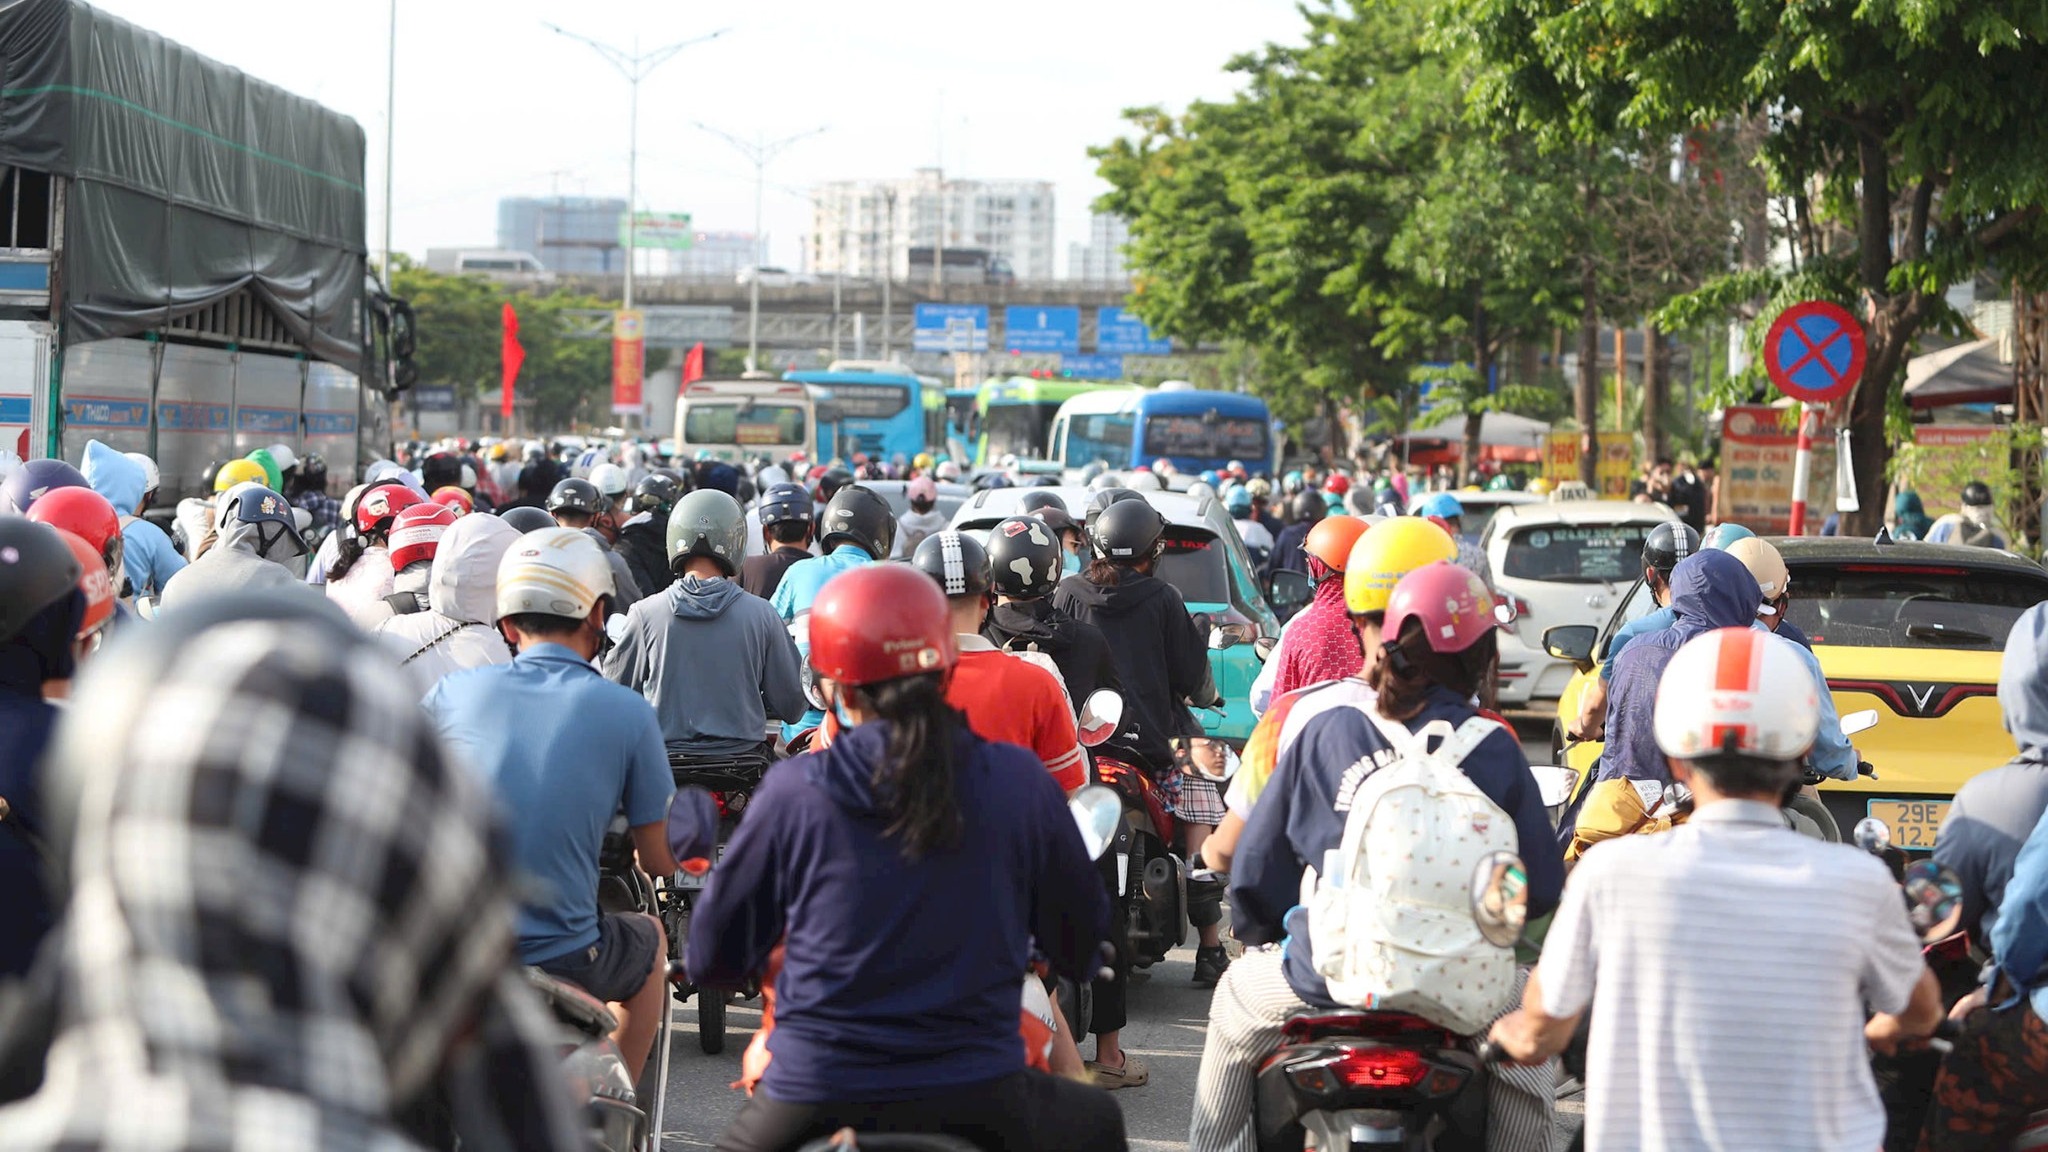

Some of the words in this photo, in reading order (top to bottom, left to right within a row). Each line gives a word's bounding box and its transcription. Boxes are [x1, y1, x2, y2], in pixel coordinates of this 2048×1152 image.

[1561, 488, 1588, 501] TAXI
[1181, 541, 1212, 551] TAXI
[1898, 804, 1938, 824] 29E
